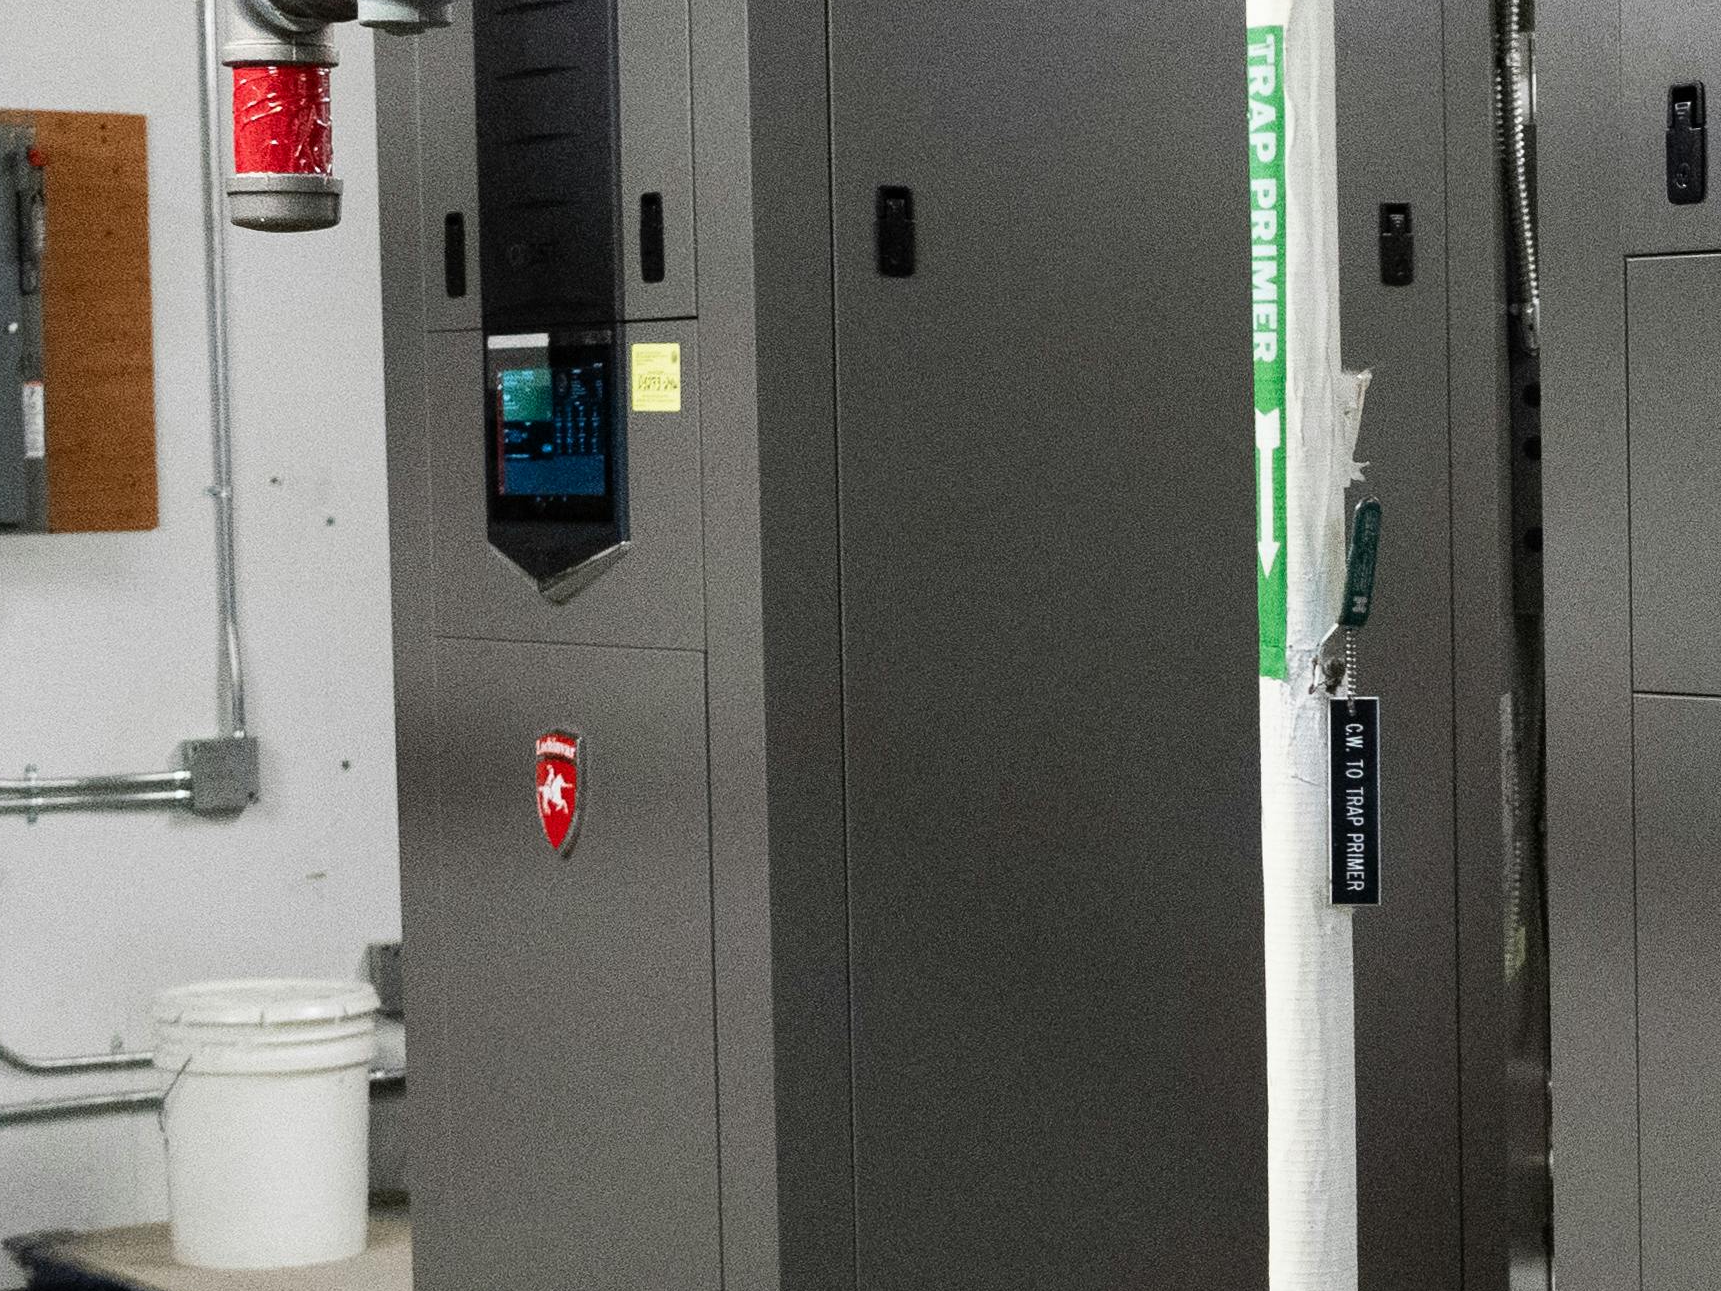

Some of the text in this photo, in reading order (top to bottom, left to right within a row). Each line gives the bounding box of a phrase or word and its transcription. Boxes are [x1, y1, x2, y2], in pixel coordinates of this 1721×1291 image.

[1247, 33, 1279, 364] TRAP PRIMER
[1344, 723, 1366, 892] C.W. TO TRAP PRIMER
